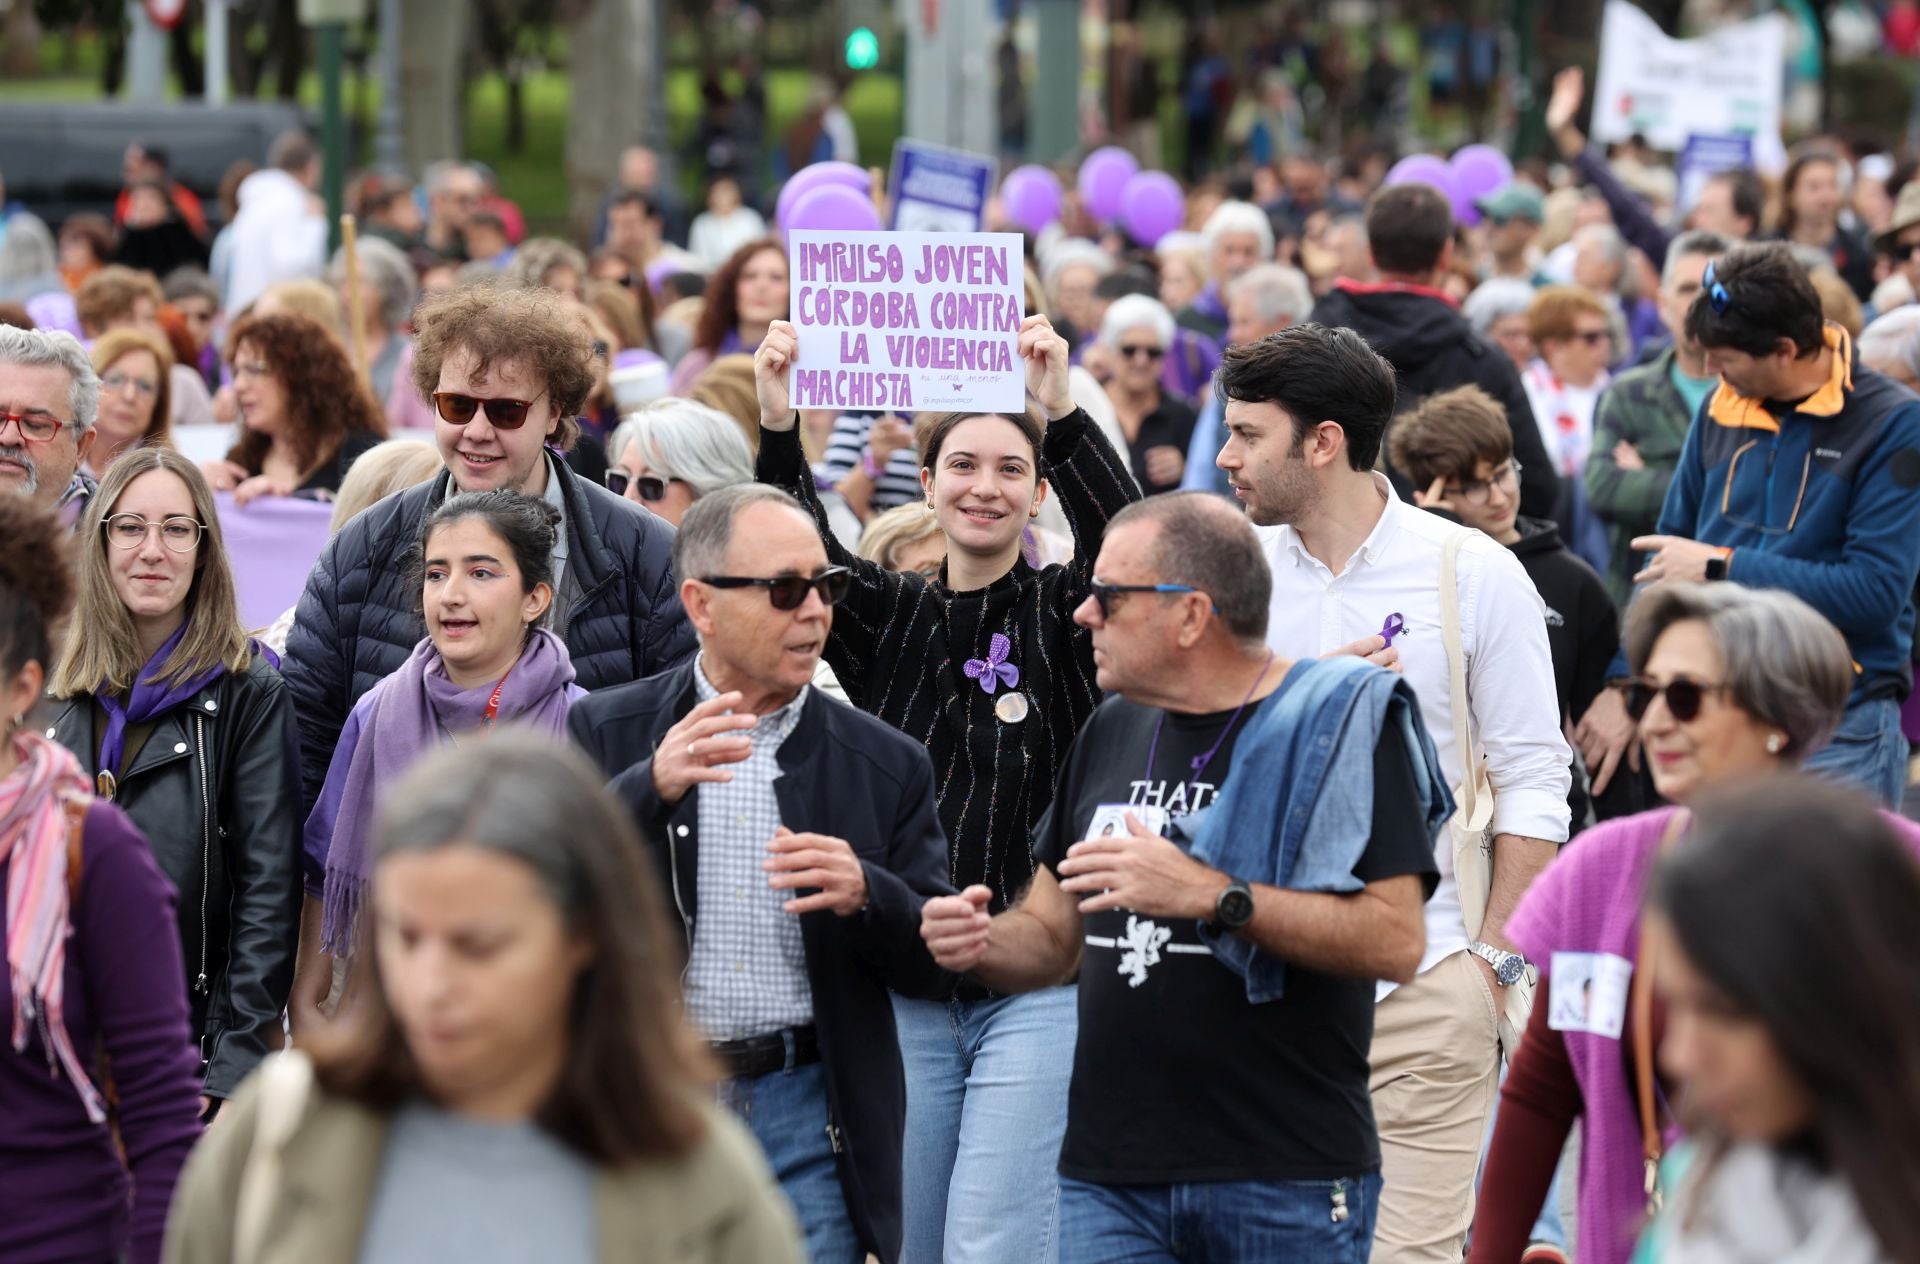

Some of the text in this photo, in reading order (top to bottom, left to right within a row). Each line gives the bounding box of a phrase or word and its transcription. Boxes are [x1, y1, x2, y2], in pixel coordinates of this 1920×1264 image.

[799, 242, 1009, 286] IMPULSO JOVEN
[799, 284, 1021, 332] CÓRDOBA CONTRA
[839, 331, 1013, 372] LA VIOLENCIA
[795, 368, 913, 407] MACHISTA
